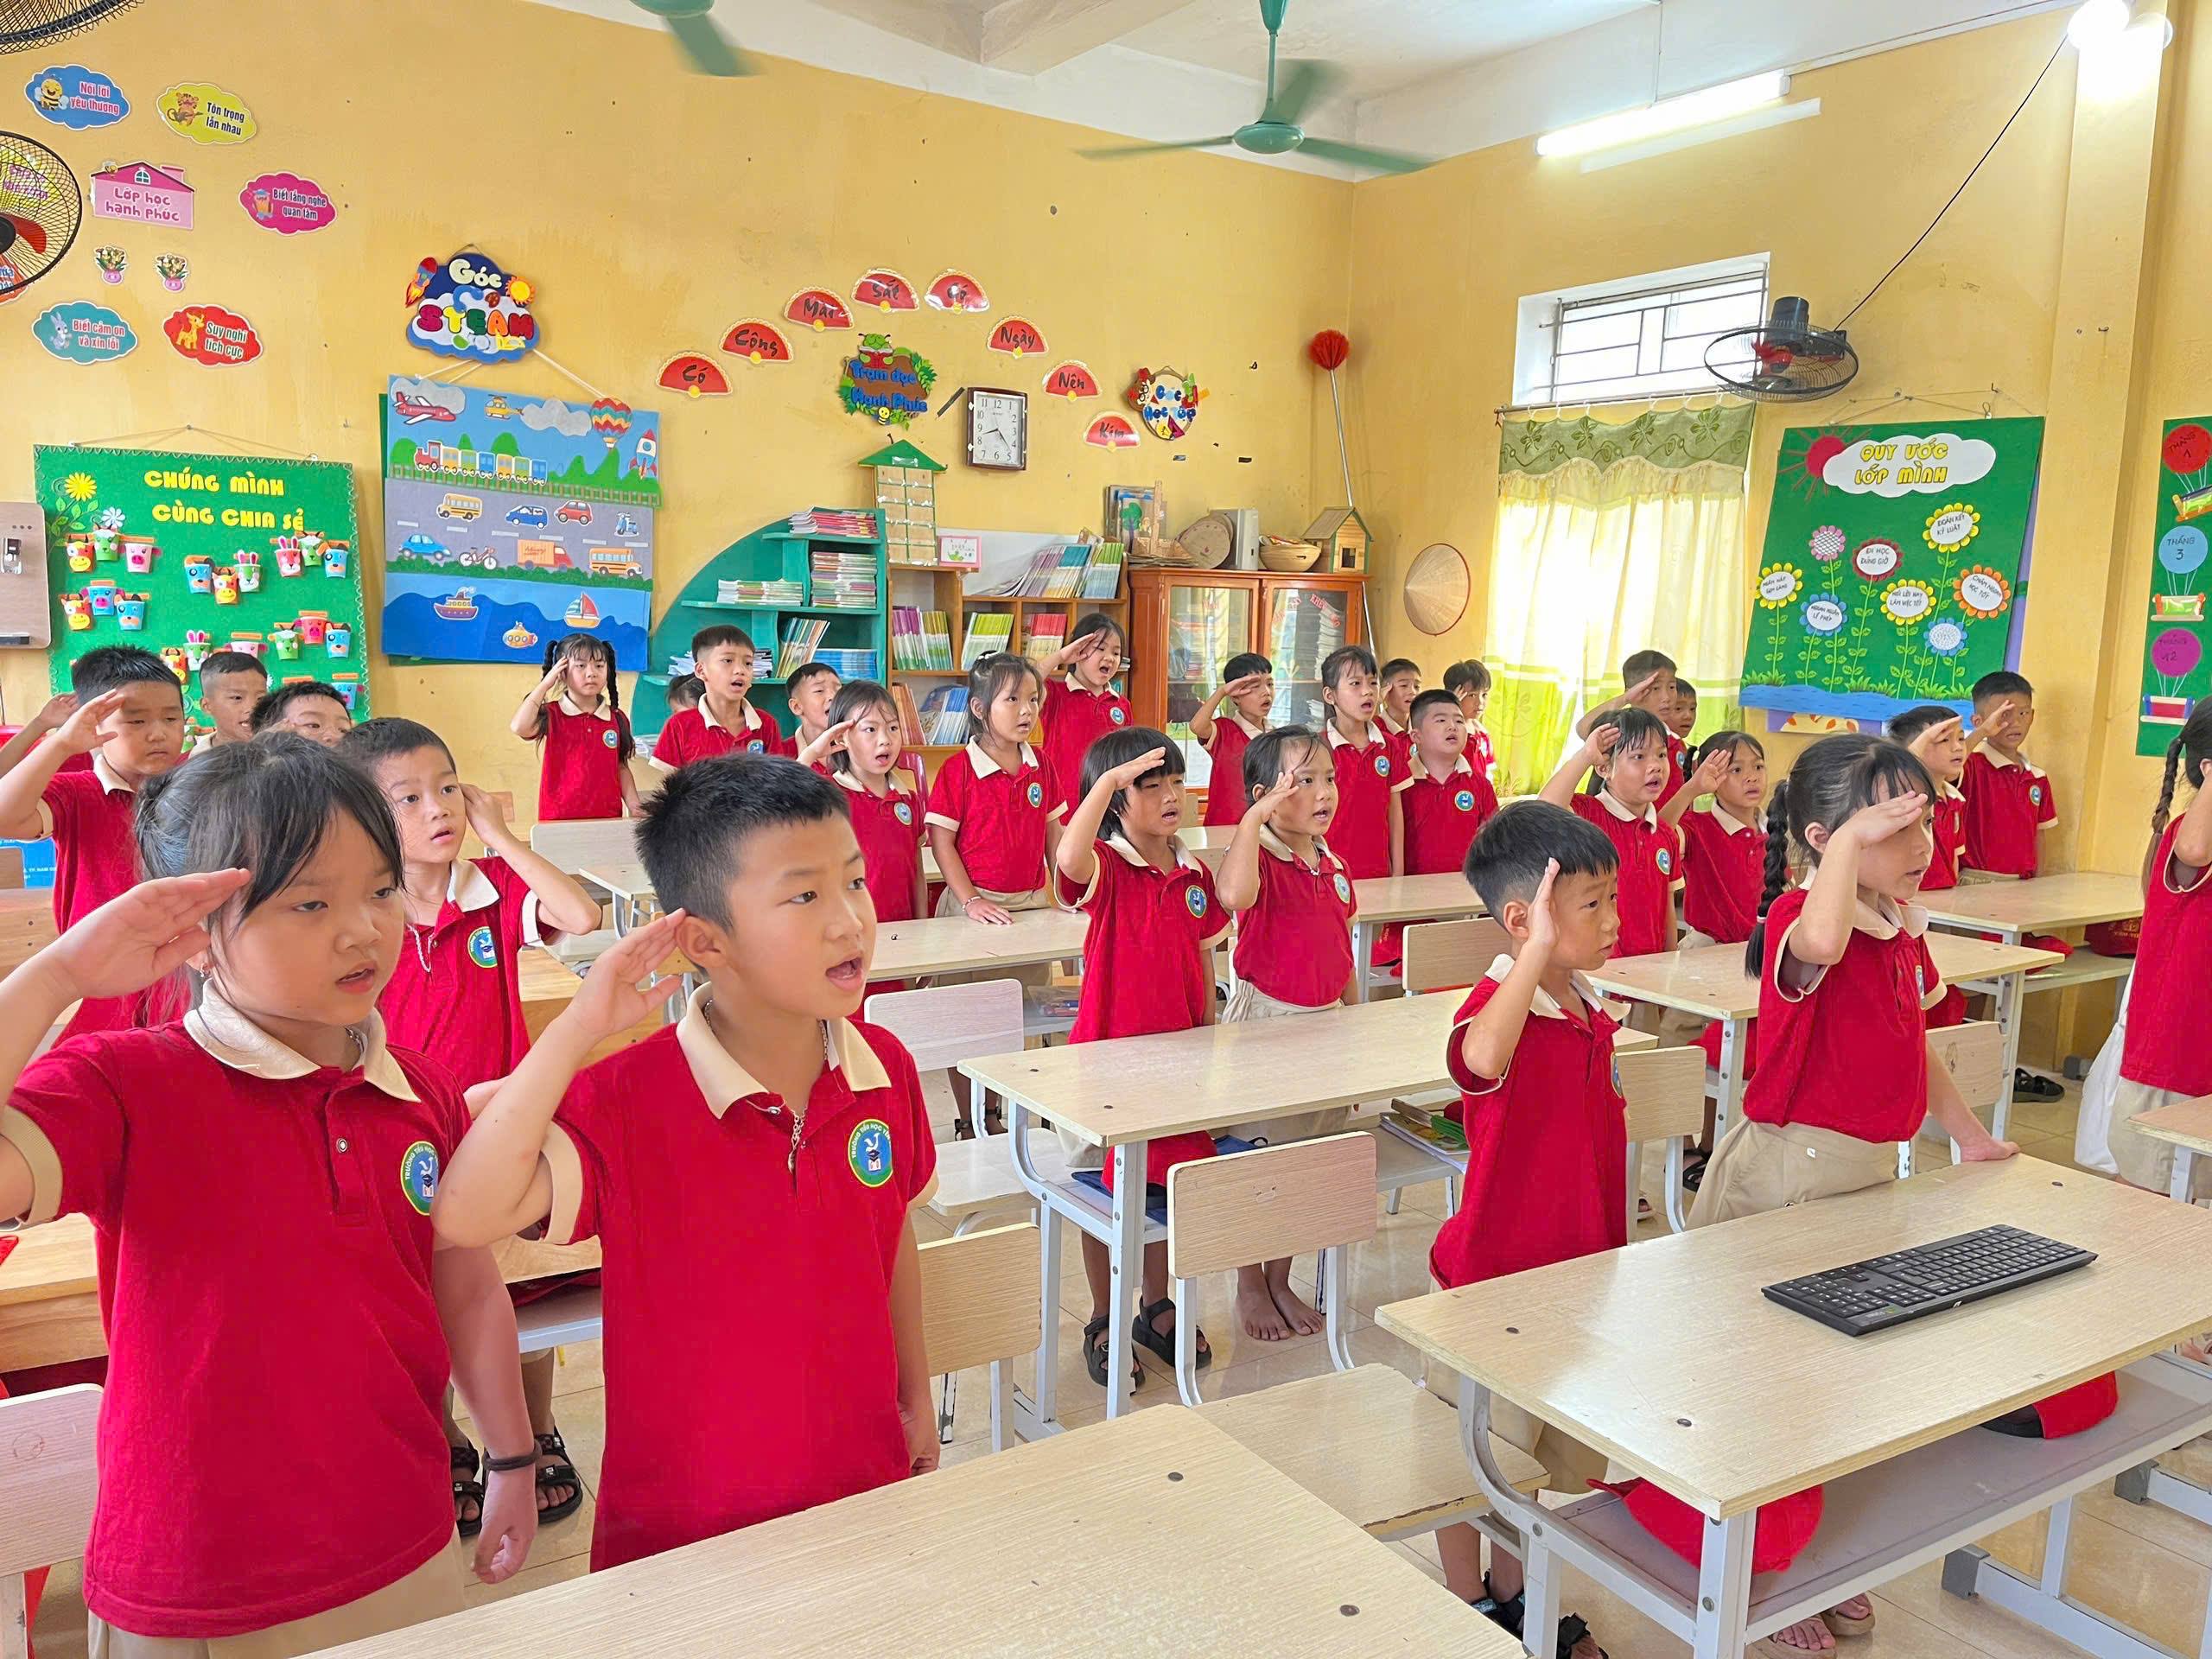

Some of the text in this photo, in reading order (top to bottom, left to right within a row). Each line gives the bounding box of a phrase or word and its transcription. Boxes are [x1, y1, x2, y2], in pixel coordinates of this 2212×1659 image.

[71, 96, 86, 109] yêu
[225, 107, 245, 123] trọng
[221, 122, 242, 136] nhau
[115, 188, 170, 207] Lớp học
[308, 195, 327, 207] nghe
[106, 201, 140, 216] hạnh
[283, 207, 301, 217] quan
[448, 258, 502, 288] Góc
[416, 304, 534, 340] STEAM
[207, 322, 224, 338] Suy
[1001, 327, 1035, 348] Ngày
[92, 337, 105, 348] xin
[735, 329, 778, 357] Công
[683, 365, 709, 384] Có
[1058, 372, 1084, 390] Nên
[982, 398, 988, 407] 11
[995, 400, 1001, 409] 12
[977, 410, 984, 419] 10
[977, 423, 982, 432] 9
[1100, 422, 1124, 438] Kim
[977, 436, 982, 445] 8
[995, 451, 999, 460] 6
[1860, 443, 1897, 461] QUY
[143, 467, 219, 493] CHÚNG
[1854, 464, 1889, 485] LỚP
[152, 499, 214, 525] CÙNG
[221, 508, 276, 528] CHIA
[2167, 535, 2196, 546] THÁNG
[2176, 549, 2184, 560] 3
